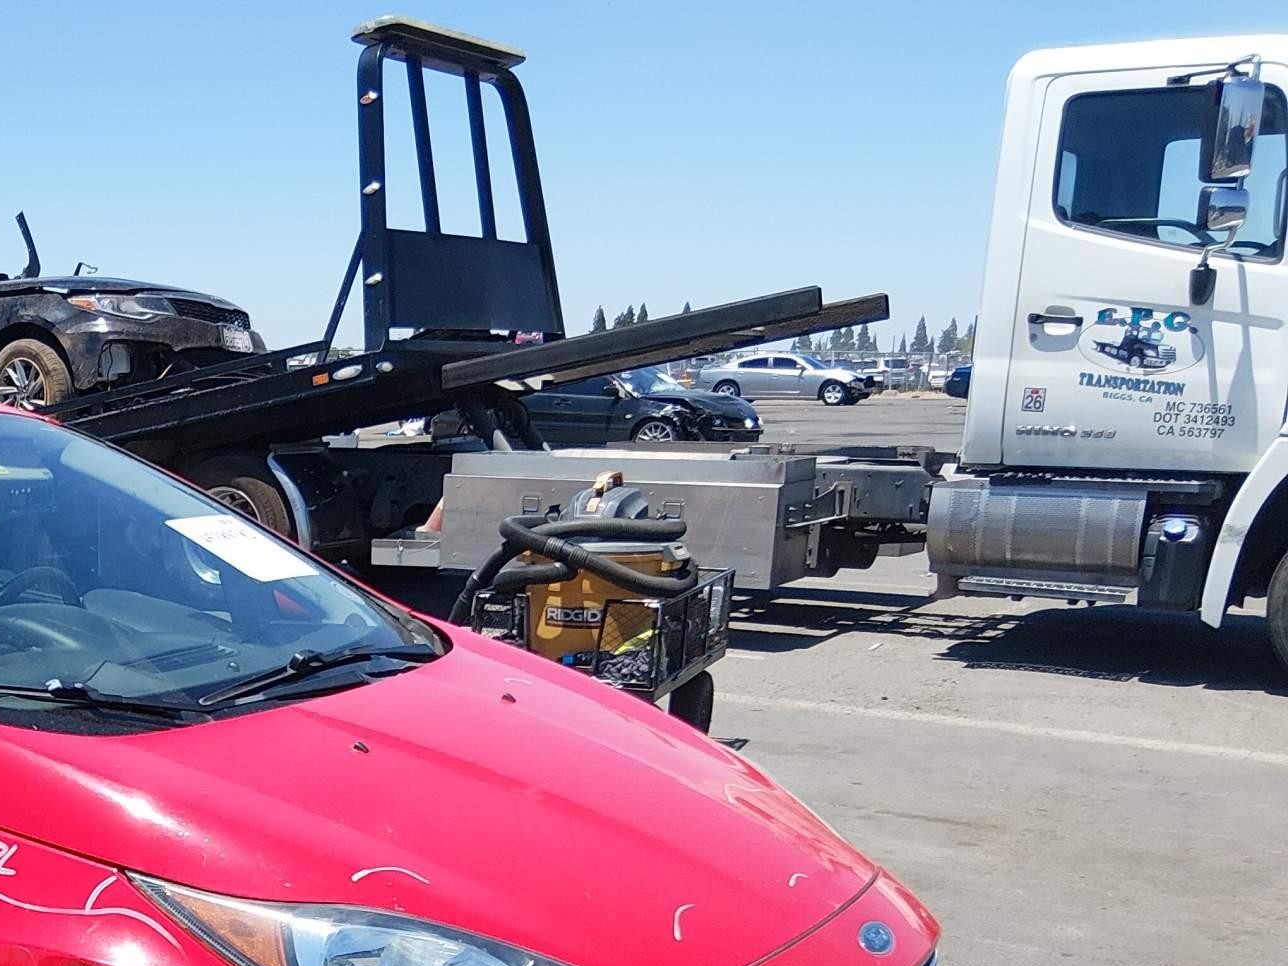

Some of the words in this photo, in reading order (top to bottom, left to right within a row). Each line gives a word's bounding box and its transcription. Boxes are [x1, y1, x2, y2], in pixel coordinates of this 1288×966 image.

[1079, 372, 1186, 397] TRANSPORTATION
[1023, 394, 1043, 410] 26
[1165, 401, 1186, 413] MC
[1189, 402, 1233, 415] 736561
[1153, 411, 1181, 424] DOT
[1183, 413, 1236, 427] 3412493
[1156, 424, 1175, 436] CA
[1178, 426, 1225, 439] 563797
[546, 607, 602, 622] RIDGID
